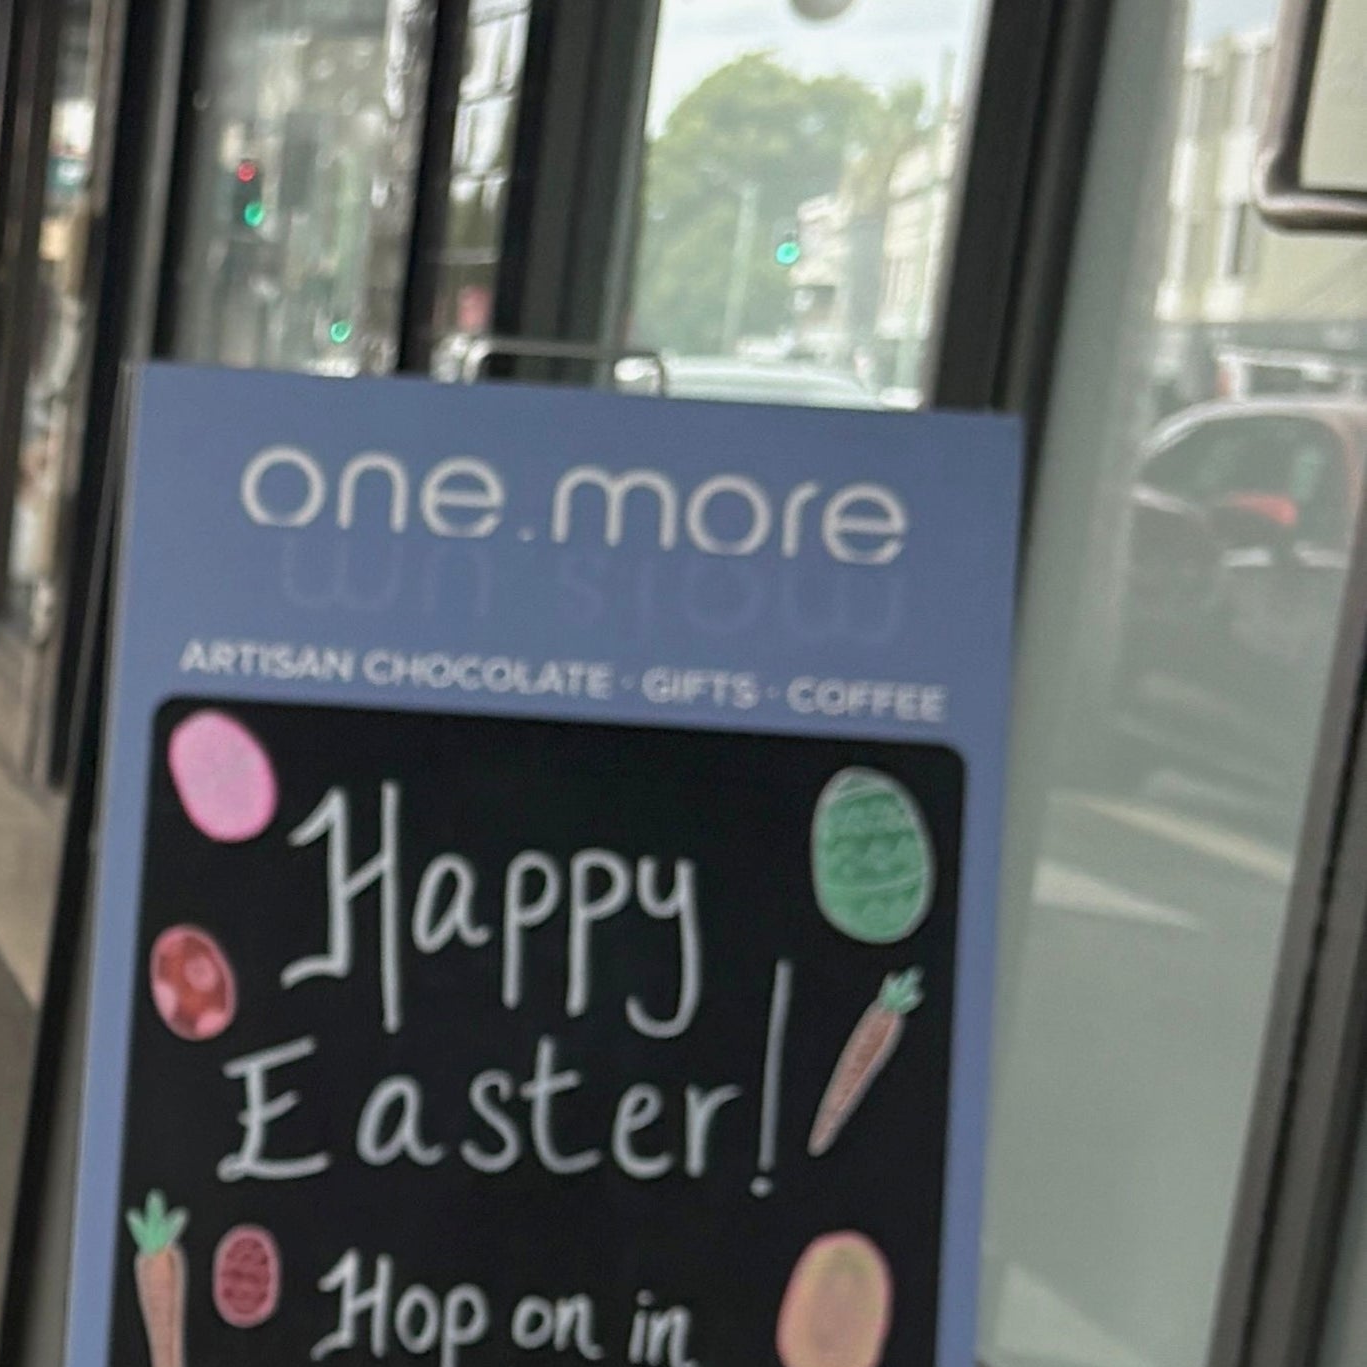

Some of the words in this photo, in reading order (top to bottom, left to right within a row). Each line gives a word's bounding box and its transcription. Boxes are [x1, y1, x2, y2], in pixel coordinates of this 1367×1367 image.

[178, 638, 356, 683] ARTISAN
[361, 648, 611, 700] CHOCOLATE
[640, 665, 761, 711] GIFTS
[785, 674, 949, 722] COFFEE
[279, 778, 701, 1039] Happy
[217, 958, 793, 1198] Easter!
[510, 1291, 603, 1362] on
